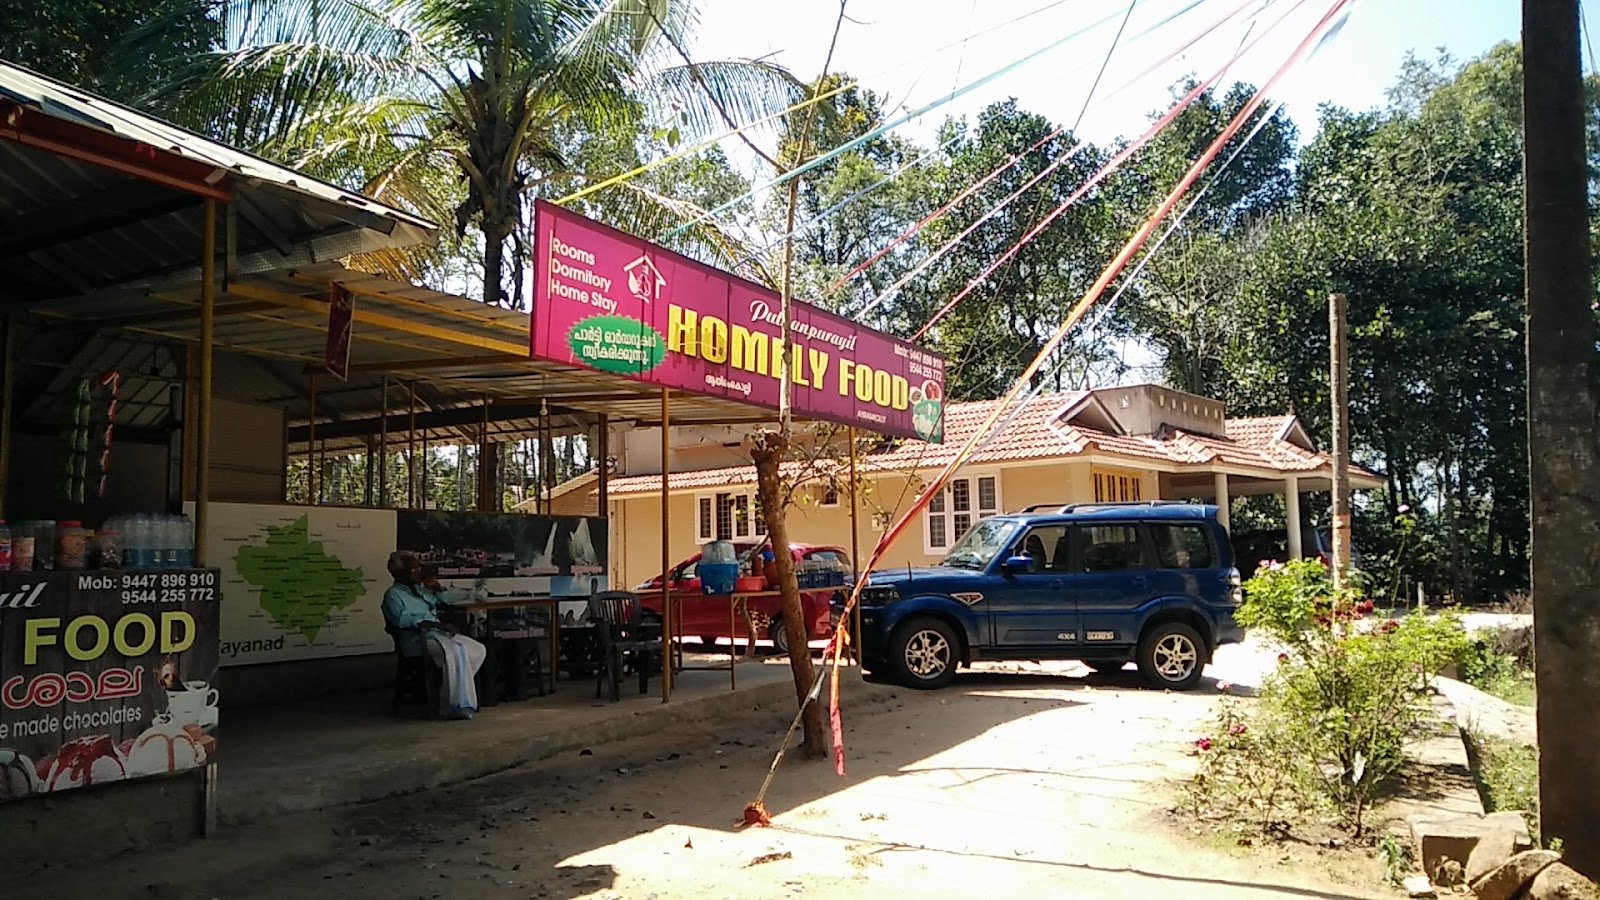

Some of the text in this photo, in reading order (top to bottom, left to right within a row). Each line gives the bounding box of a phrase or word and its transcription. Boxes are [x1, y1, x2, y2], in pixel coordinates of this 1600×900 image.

[553, 237, 596, 266] Rooms
[552, 257, 612, 293] Dormitory
[551, 278, 618, 315] Home Stay
[749, 299, 858, 351] Putanpurayil
[668, 303, 909, 412] HOMELY FOOD
[78, 573, 215, 590] Mob: 9447 896 910
[121, 588, 215, 605] 9544 255 772
[23, 610, 196, 665] FOOD
[219, 635, 284, 658] ayanad
[13, 714, 59, 738] made
[63, 706, 142, 731] chocolates
